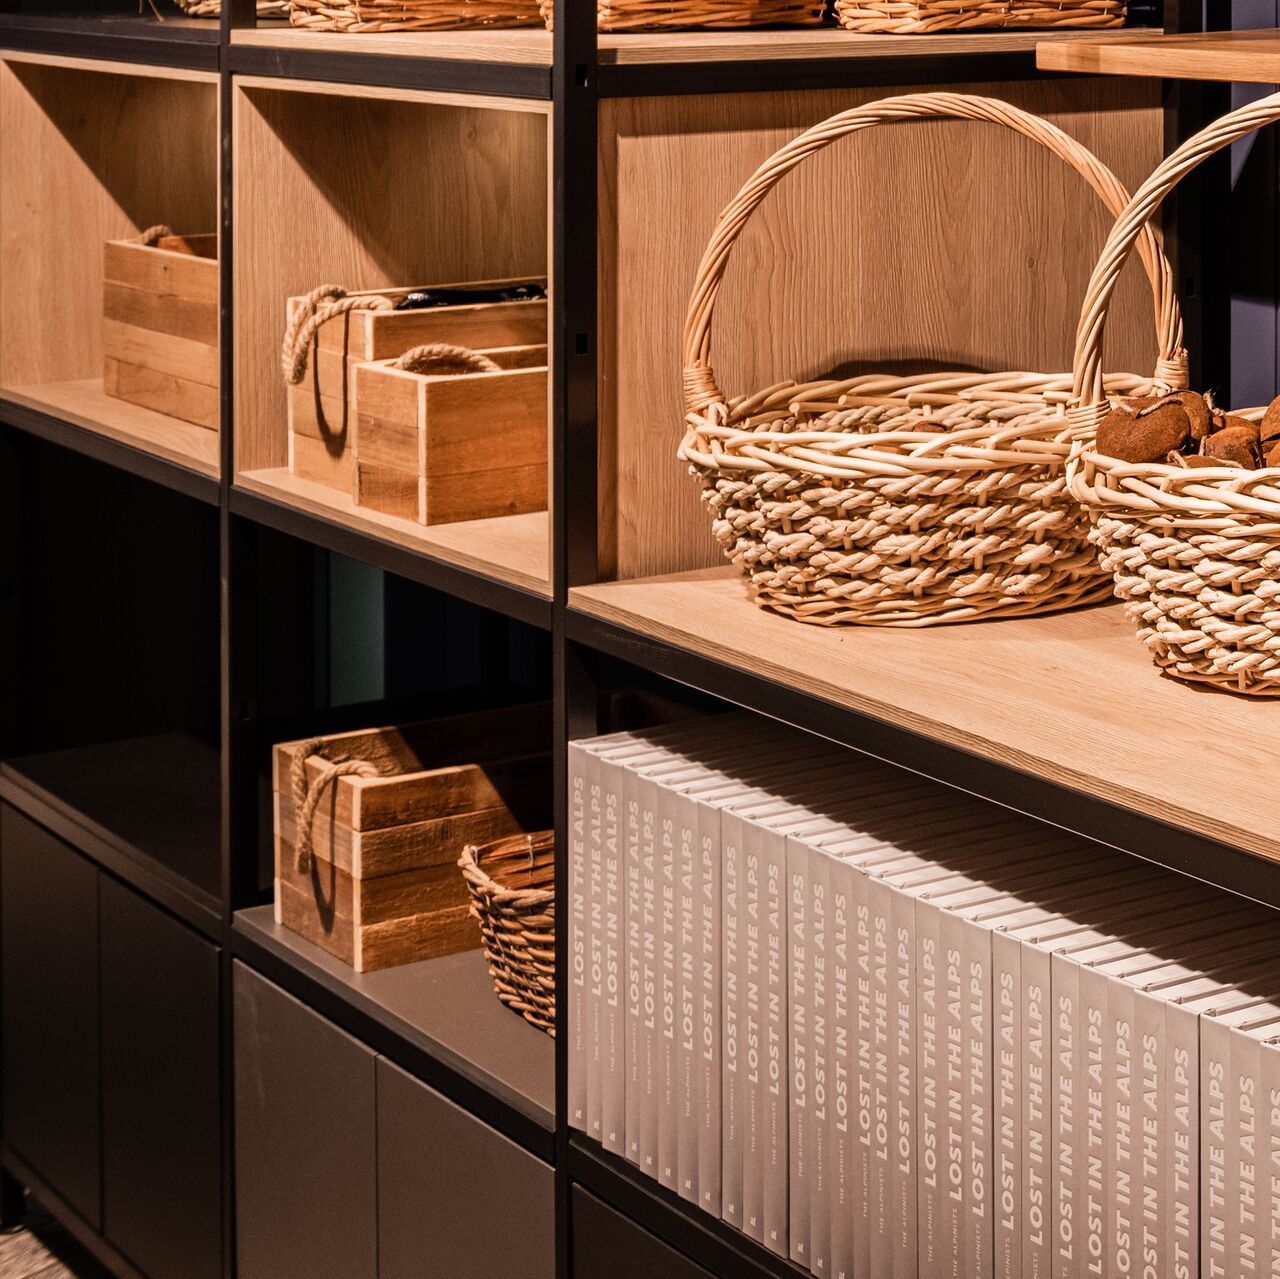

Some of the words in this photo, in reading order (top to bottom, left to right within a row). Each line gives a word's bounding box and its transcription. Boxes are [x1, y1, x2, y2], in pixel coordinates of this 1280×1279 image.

[573, 776, 584, 836] ALPS
[606, 793, 618, 854] ALPS
[629, 801, 639, 862] ALPS
[573, 839, 584, 887] THE
[662, 819, 674, 881] ALPS
[681, 829, 693, 891] ALPS
[702, 836, 713, 900] ALPS
[726, 846, 737, 910] ALPS
[573, 893, 584, 920] IN
[606, 857, 618, 906] THE
[629, 866, 639, 914] THE
[662, 885, 674, 934] THE
[747, 855, 759, 920] ALPS
[768, 864, 779, 930] ALPS
[793, 874, 805, 941] ALPS
[606, 912, 618, 939] IN
[629, 920, 640, 948] IN
[681, 895, 693, 945] THE
[702, 904, 713, 954] THE
[726, 914, 737, 965] THE
[813, 884, 825, 951] ALPS
[835, 894, 847, 962] ALPS
[857, 905, 870, 973] ALPS
[573, 924, 584, 987] LOST
[606, 943, 618, 1007] LOST
[663, 941, 674, 969] IN
[682, 951, 693, 981] IN
[702, 961, 713, 990] IN
[747, 923, 759, 975] THE
[768, 933, 779, 985] THE
[793, 944, 805, 997] THE
[874, 916, 887, 986] ALPS
[897, 927, 910, 998] ALPS
[923, 938, 936, 1009] ALPS
[629, 952, 640, 1017] LOST
[663, 973, 674, 1039] LOST
[726, 971, 737, 1001] IN
[747, 981, 759, 1012] IN
[768, 992, 780, 1022] IN
[814, 954, 825, 1008] THE
[835, 965, 847, 1019] THE
[857, 977, 870, 1031] THE
[947, 949, 961, 1021] ALPS
[970, 962, 984, 1035] ALPS
[1000, 973, 1014, 1046] ALPS
[682, 984, 694, 1051] LOST
[702, 993, 713, 1061] LOST
[726, 1004, 737, 1073] LOST
[793, 1003, 806, 1034] IN
[814, 1014, 825, 1046] IN
[835, 1026, 848, 1057] IN
[875, 990, 888, 1045] THE
[897, 1001, 910, 1057] THE
[923, 1013, 936, 1069] THE
[1028, 985, 1043, 1060] ALPS
[1059, 996, 1073, 1072] ALPS
[1088, 1008, 1103, 1085] ALPS
[747, 1015, 759, 1084] LOST
[768, 1026, 780, 1096] LOST
[794, 1037, 806, 1108] LOST
[858, 1038, 871, 1070] IN
[875, 1051, 888, 1084] IN
[898, 1064, 910, 1096] IN
[947, 1025, 962, 1082] THE
[970, 1038, 984, 1096] THE
[1000, 1050, 1014, 1108] THE
[1116, 1021, 1131, 1098] ALPS
[1142, 1034, 1158, 1113] ALPS
[814, 1049, 826, 1121] LOST
[835, 1060, 848, 1133] LOST
[858, 1073, 872, 1146] LOST
[923, 1076, 936, 1109] IN
[948, 1089, 962, 1122] IN
[1029, 1063, 1043, 1122] THE
[1059, 1075, 1073, 1134] THE
[1174, 1048, 1190, 1128] ALPS
[1208, 1061, 1225, 1142] ALPS
[875, 1087, 888, 1161] LOST
[898, 1099, 910, 1175] LOST
[971, 1103, 984, 1137] IN
[1000, 1115, 1015, 1149] IN
[1029, 1129, 1043, 1164] IN
[1087, 1088, 1103, 1148] THE
[1116, 1102, 1131, 1162] THE
[1142, 1116, 1158, 1178] THE
[1239, 1076, 1255, 1157] ALPS
[923, 1112, 937, 1188] LOST
[948, 1126, 963, 1202] LOST
[971, 1140, 985, 1218] LOST
[1059, 1142, 1073, 1177] IN
[1087, 1155, 1103, 1191] IN
[1174, 1131, 1190, 1193] THE
[1209, 1145, 1225, 1208] THE
[1000, 1153, 1015, 1231] LOST
[1028, 1167, 1044, 1247] LOST
[1115, 1170, 1131, 1206] IN
[1142, 1185, 1158, 1222] IN
[1239, 1161, 1256, 1224] THE
[1059, 1180, 1073, 1261] LOST
[1087, 1194, 1103, 1275] LOST
[1115, 1209, 1131, 1279] OST
[1174, 1201, 1190, 1238] IN
[1209, 1216, 1225, 1253] IN
[1239, 1233, 1256, 1271] IN
